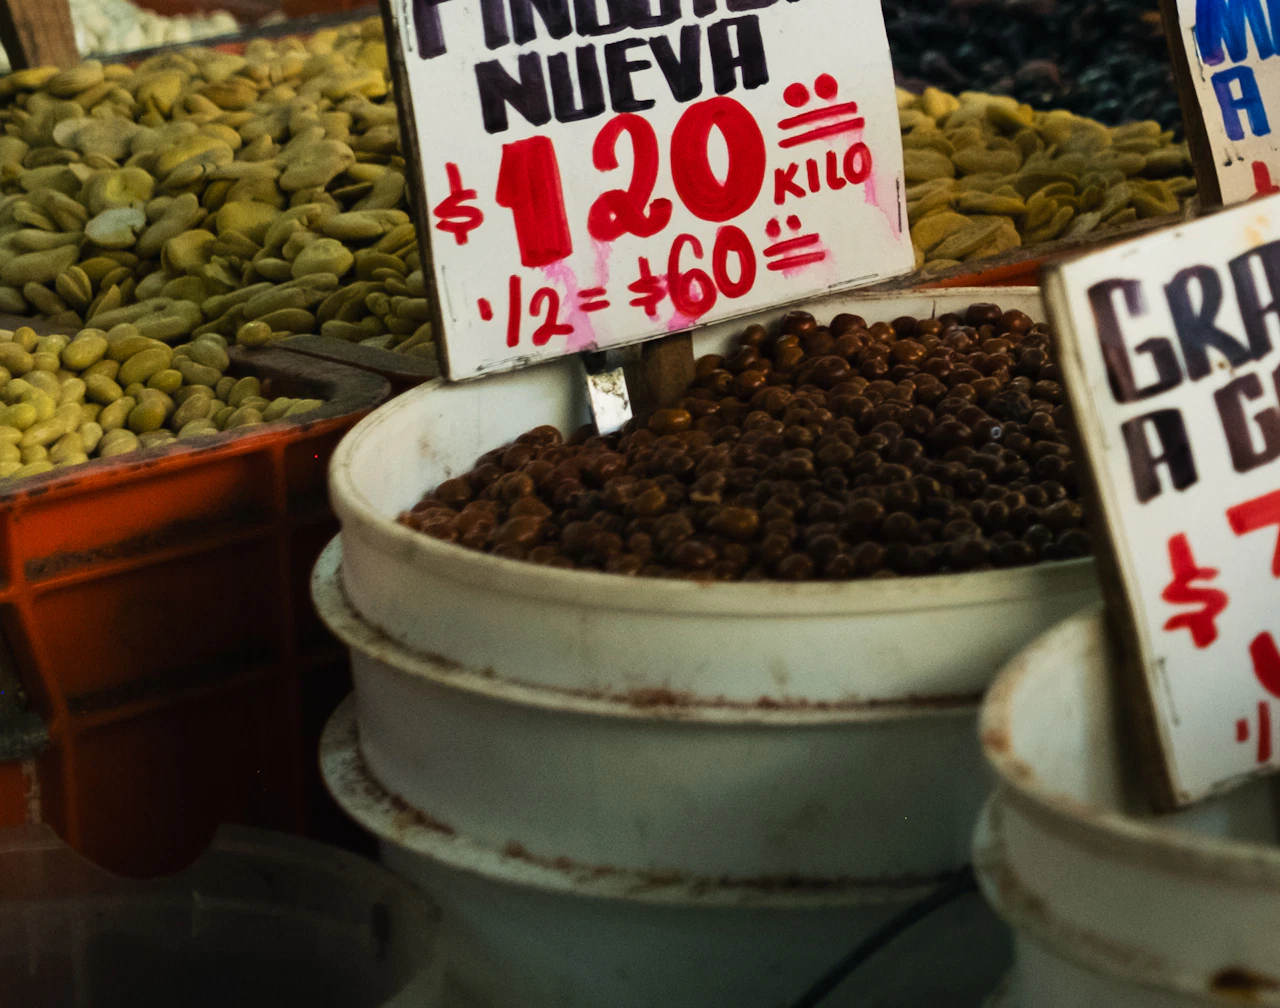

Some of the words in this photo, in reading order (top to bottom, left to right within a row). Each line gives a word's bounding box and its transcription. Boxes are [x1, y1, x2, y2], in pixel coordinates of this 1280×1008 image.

[475, 14, 769, 133] NUEVA
[1211, 65, 1271, 141] A
[434, 95, 766, 268] $120
[773, 141, 872, 206] KILO
[1121, 406, 1199, 504] A
